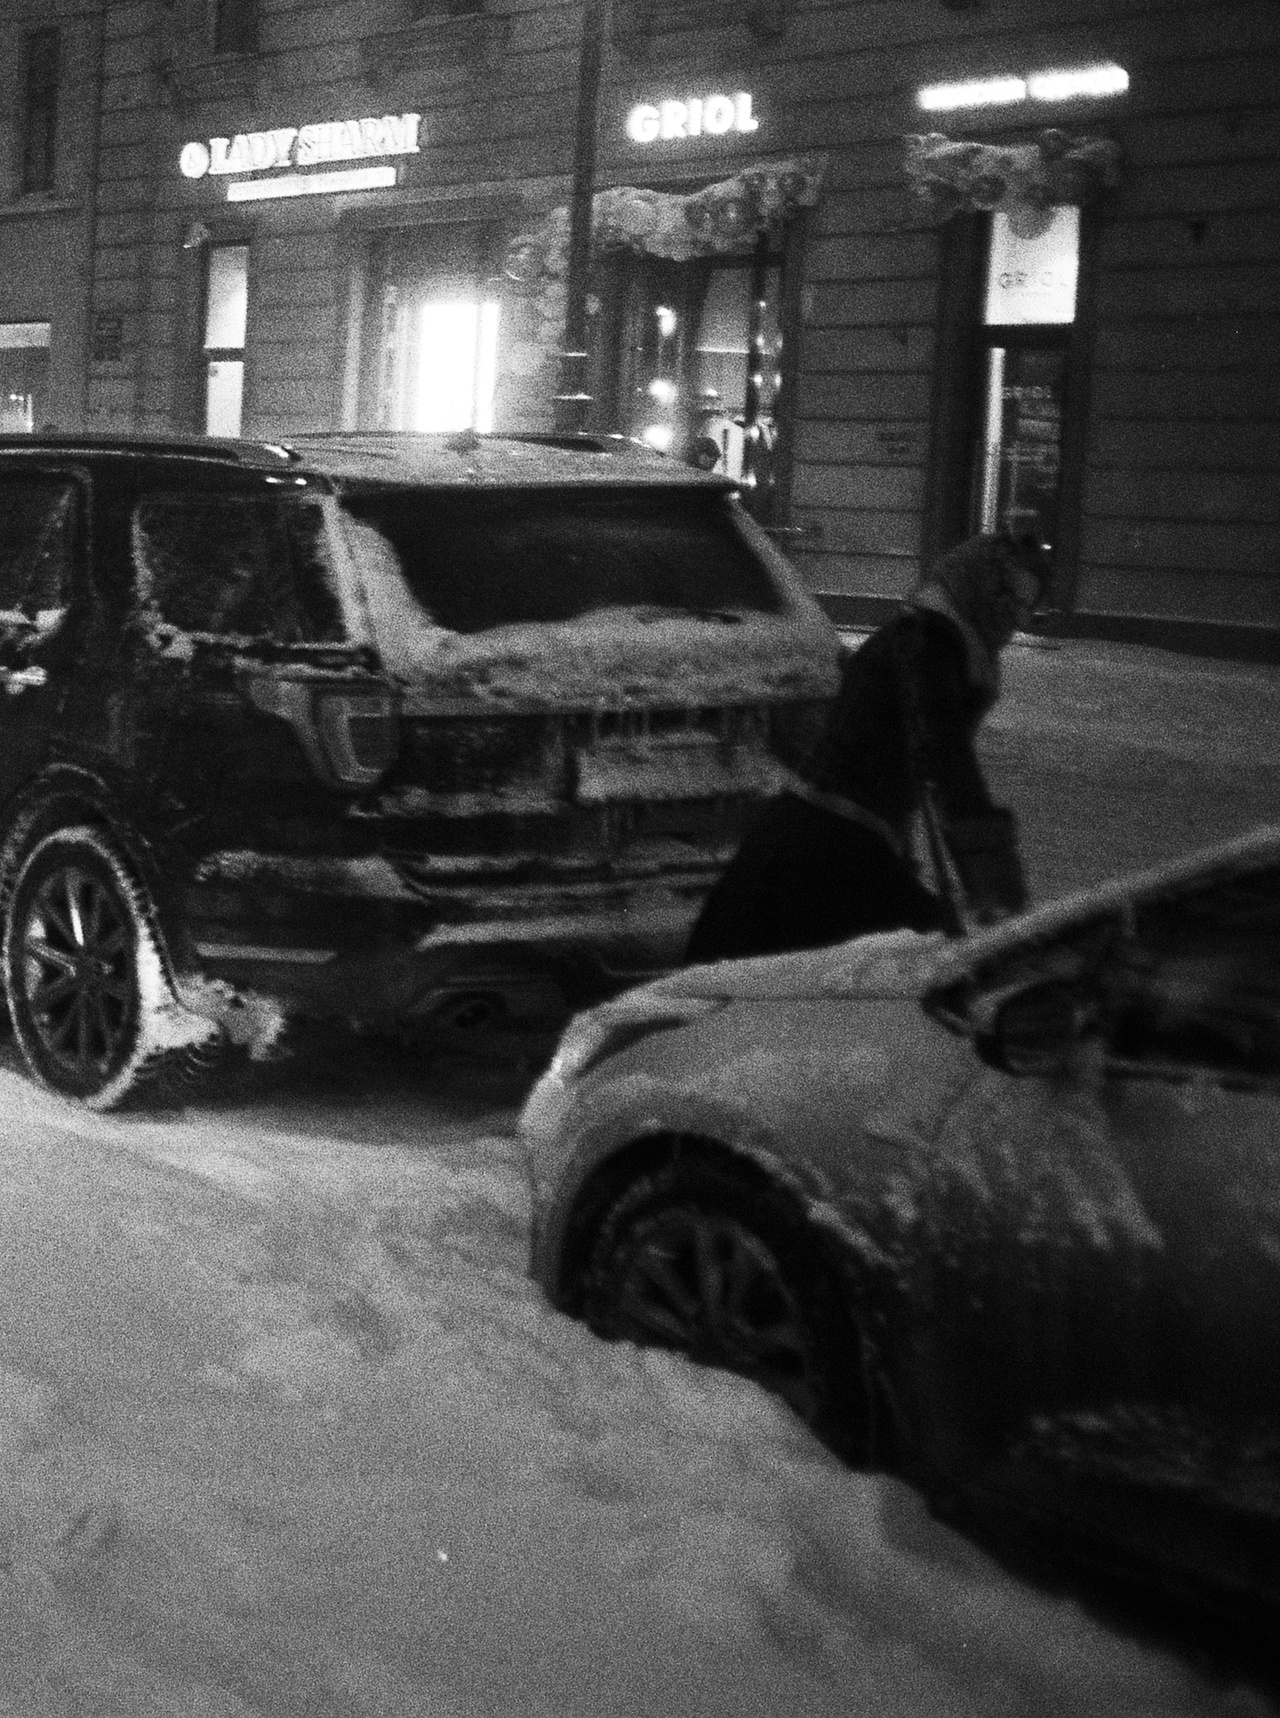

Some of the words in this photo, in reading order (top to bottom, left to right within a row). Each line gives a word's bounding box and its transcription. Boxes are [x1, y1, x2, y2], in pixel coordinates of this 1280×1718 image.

[627, 92, 759, 142] GRIOL
[208, 127, 298, 175] LADY
[297, 113, 421, 166] SHARM
[998, 271, 1069, 290] GROL
